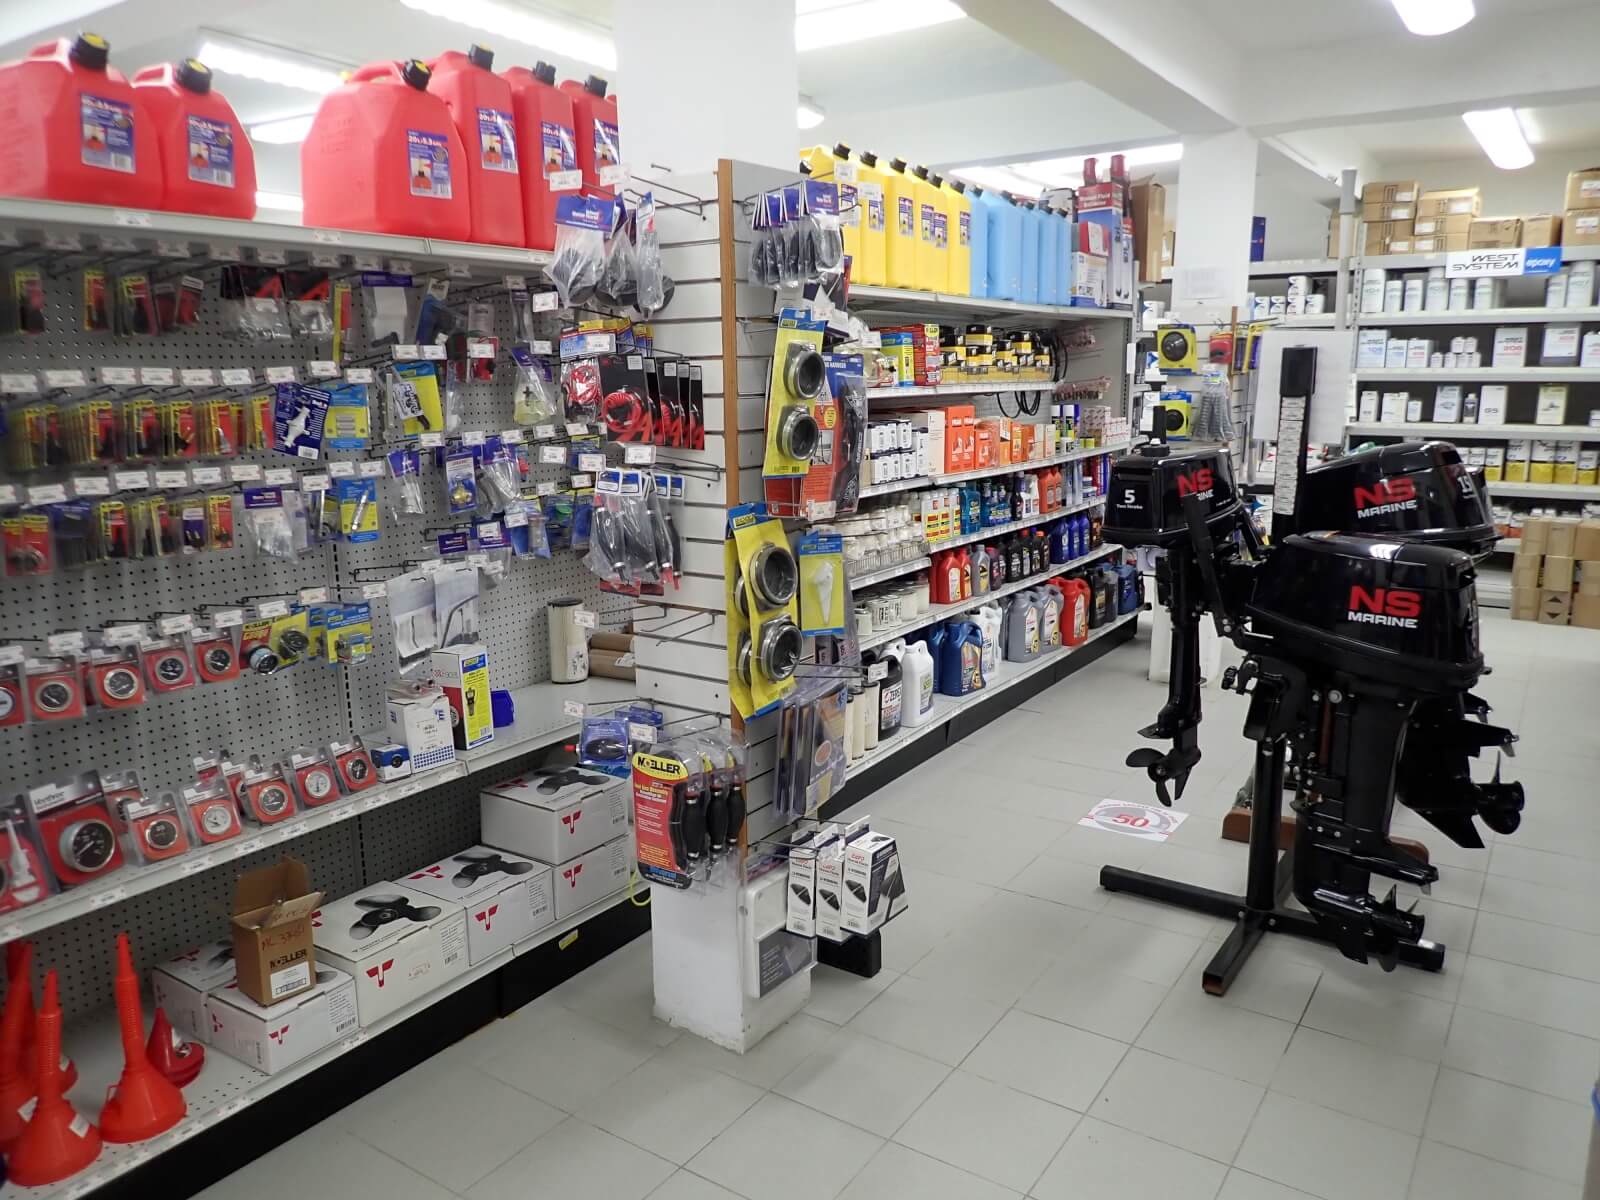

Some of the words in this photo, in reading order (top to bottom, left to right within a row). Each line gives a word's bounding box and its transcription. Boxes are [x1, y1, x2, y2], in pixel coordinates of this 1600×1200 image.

[1452, 261, 1519, 271] SYSTEM
[1472, 253, 1519, 262] WEST
[1177, 469, 1215, 498] NS
[1124, 489, 1136, 504] 5
[1353, 478, 1417, 509] NS
[1357, 500, 1418, 519] MARINE
[1349, 585, 1421, 618] NS
[1347, 611, 1419, 629] MARINE
[1112, 813, 1150, 828] 50
